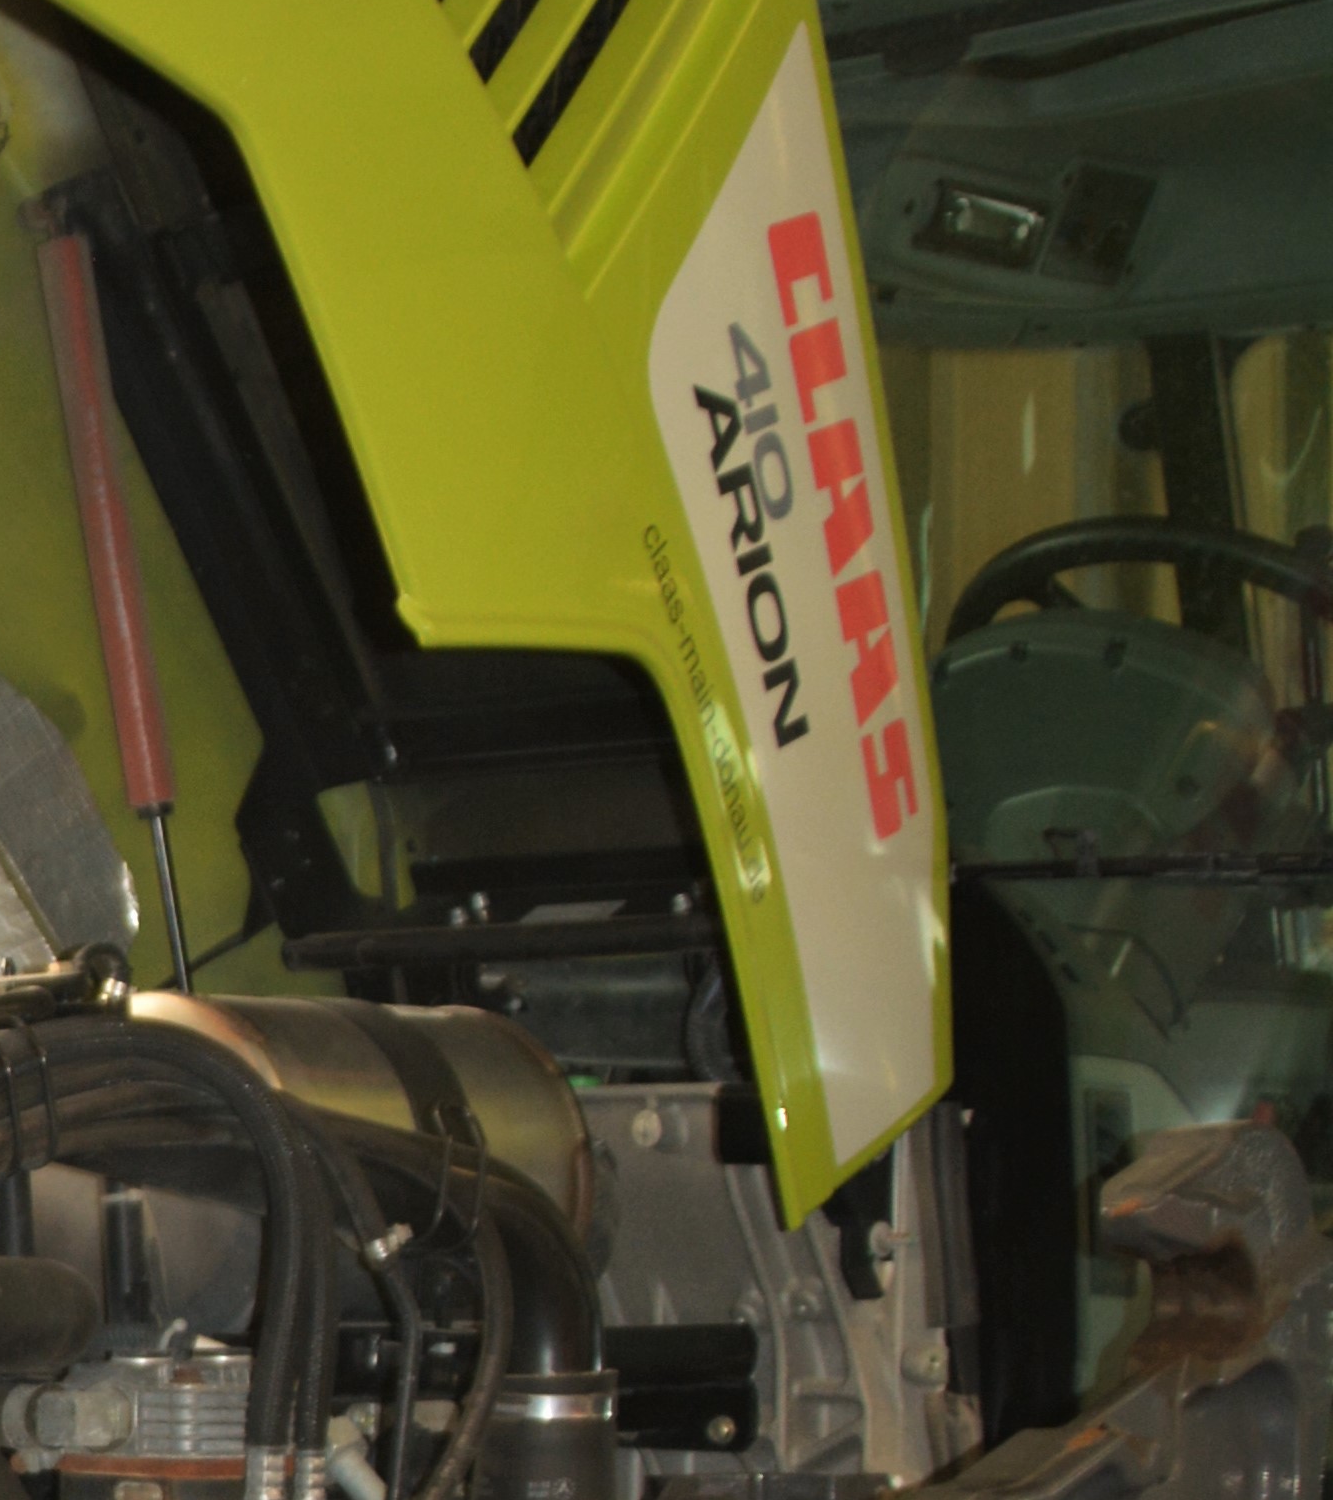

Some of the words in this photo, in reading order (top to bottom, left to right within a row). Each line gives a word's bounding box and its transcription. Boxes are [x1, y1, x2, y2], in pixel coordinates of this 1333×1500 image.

[693, 384, 811, 750] ARION
[728, 322, 794, 522] 410
[767, 211, 919, 841] CLAAS
[643, 522, 766, 902] claas-main-donau.de
